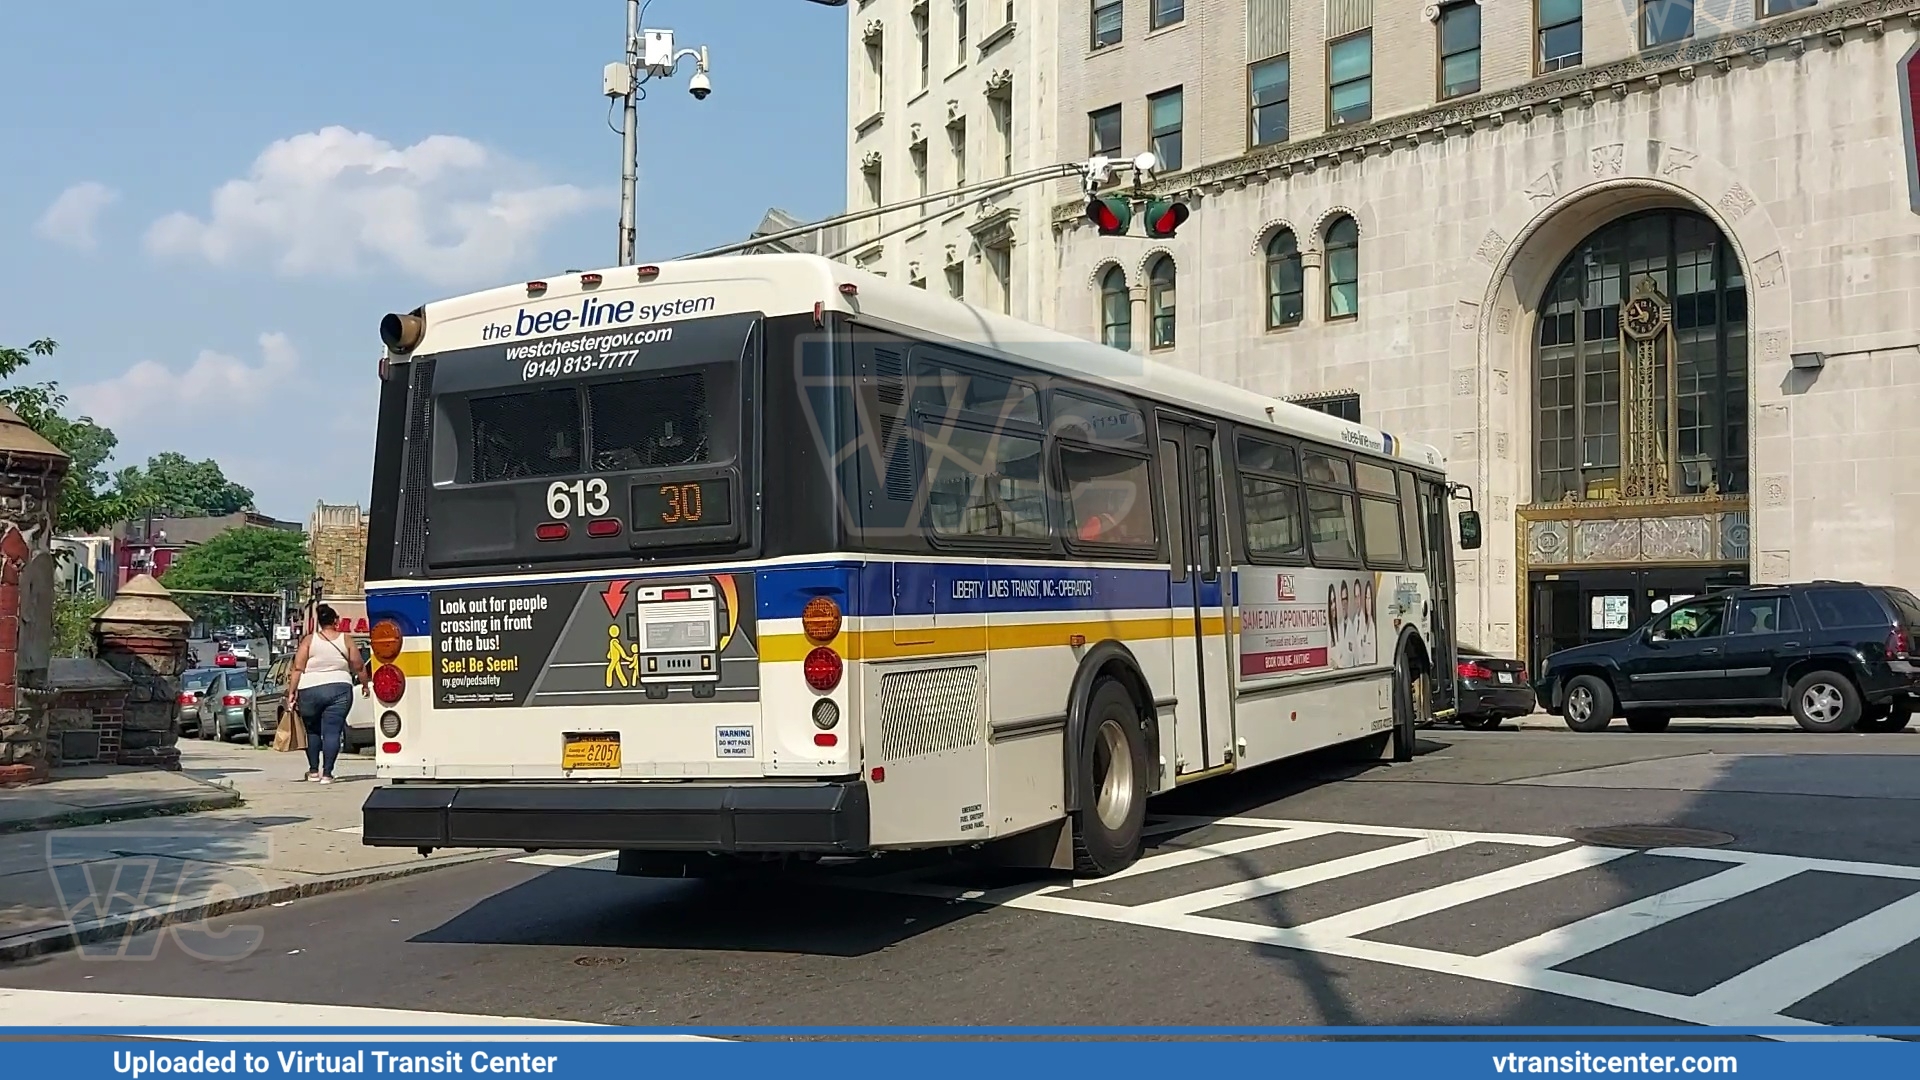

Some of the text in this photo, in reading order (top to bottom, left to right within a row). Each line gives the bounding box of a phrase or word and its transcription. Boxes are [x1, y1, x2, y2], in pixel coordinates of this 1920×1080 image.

[483, 296, 715, 340] the bee-line system
[506, 326, 673, 361] westchestergov.com
[522, 350, 640, 381] (914) 813-7777
[546, 478, 610, 520] 613
[660, 483, 702, 523] 30
[952, 580, 984, 598] LIBERTY
[988, 580, 1009, 598] LINES
[1011, 580, 1042, 599] TRANSIT,
[440, 594, 548, 614] Look out for people
[440, 614, 532, 634] crossing in front
[1243, 610, 1326, 630] SAME DAY APPOINTMENTS
[441, 634, 500, 652] of the bus!
[442, 655, 518, 673] See! Be Seen!
[442, 674, 500, 688] ny.gov/pedsafety
[594, 744, 620, 761] 2057
